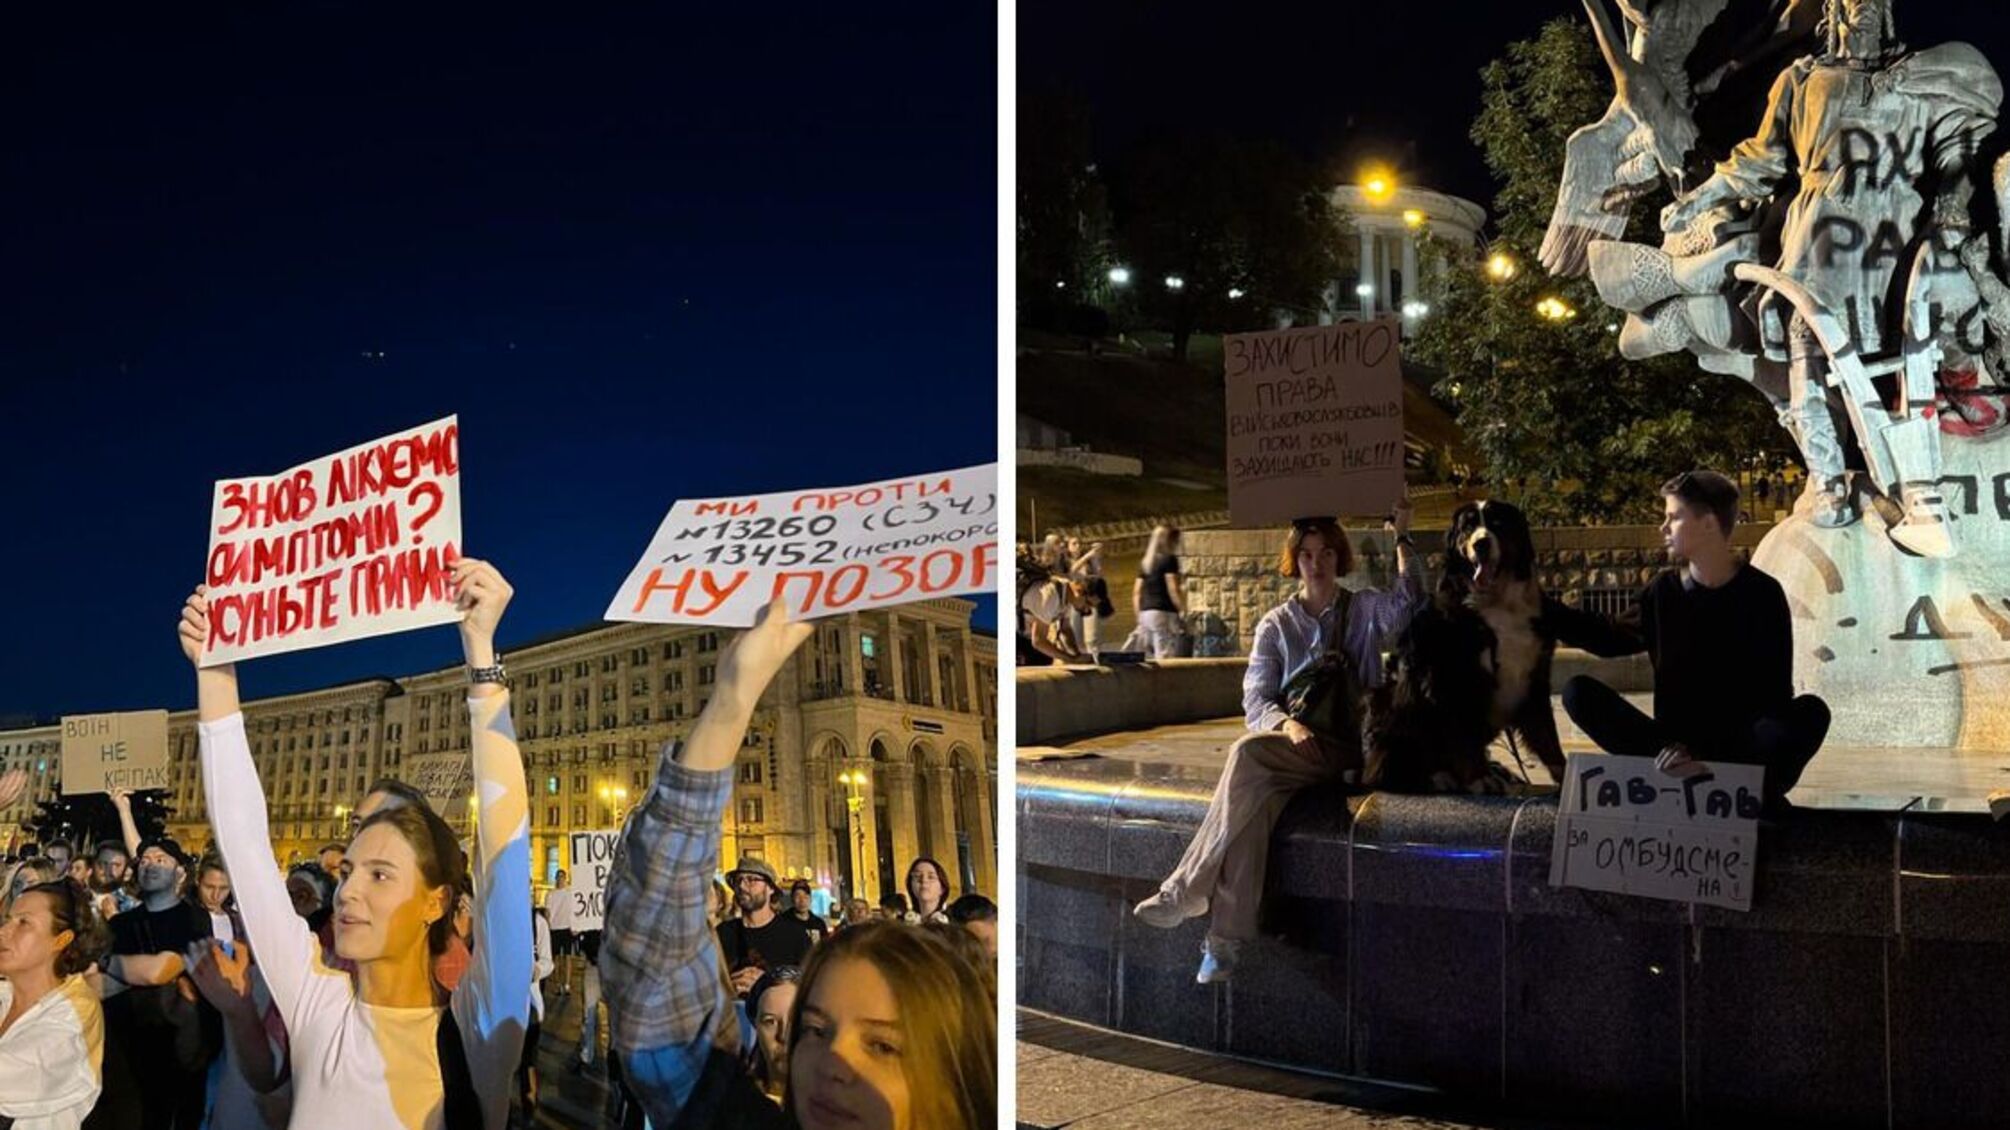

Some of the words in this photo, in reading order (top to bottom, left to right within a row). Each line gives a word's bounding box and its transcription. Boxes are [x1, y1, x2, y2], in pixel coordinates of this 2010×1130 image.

[1230, 325, 1392, 376] ЗАХИСТИМО
[1256, 375, 1338, 408] ПРАВА
[1258, 434, 1300, 453] ПОКИ
[1310, 431, 1349, 449] ВОНИ
[1342, 441, 1397, 469] НАС!!!
[218, 469, 317, 535] ЗНОВ
[695, 499, 759, 516] МИ
[792, 478, 950, 512] ПРОТИ
[632, 568, 749, 617] НУ
[101, 741, 128, 762] НЕ
[104, 767, 166, 790] КРІПАК
[572, 833, 618, 865] ПОК
[574, 891, 605, 917] ЗЛО
